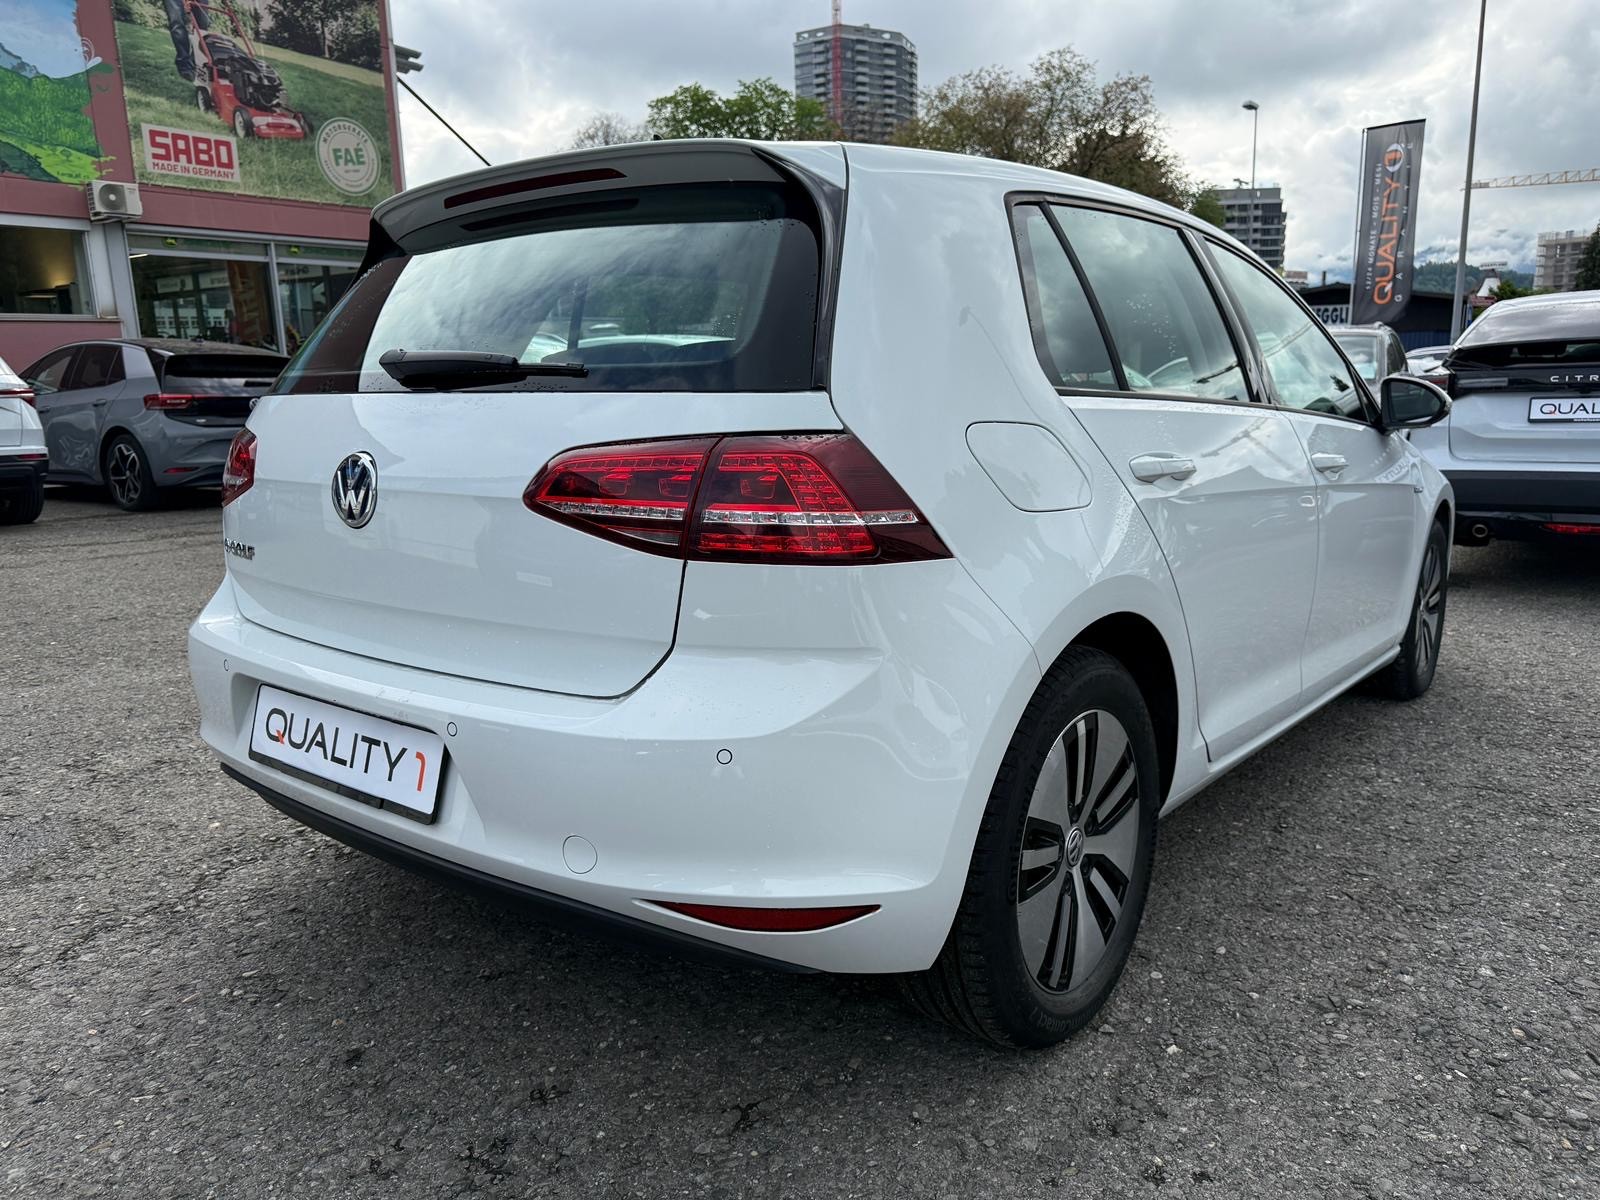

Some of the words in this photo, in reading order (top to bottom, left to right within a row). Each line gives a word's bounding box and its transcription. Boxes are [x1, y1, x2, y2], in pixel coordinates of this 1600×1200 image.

[148, 129, 234, 170] SABO
[332, 142, 367, 167] FAÉ
[152, 162, 179, 173] MADE
[180, 166, 190, 174] IN
[192, 167, 235, 179] GERMANY
[1371, 200, 1380, 219] MOIS
[1368, 229, 1378, 264] MONATE
[1373, 177, 1402, 305] QUALITY
